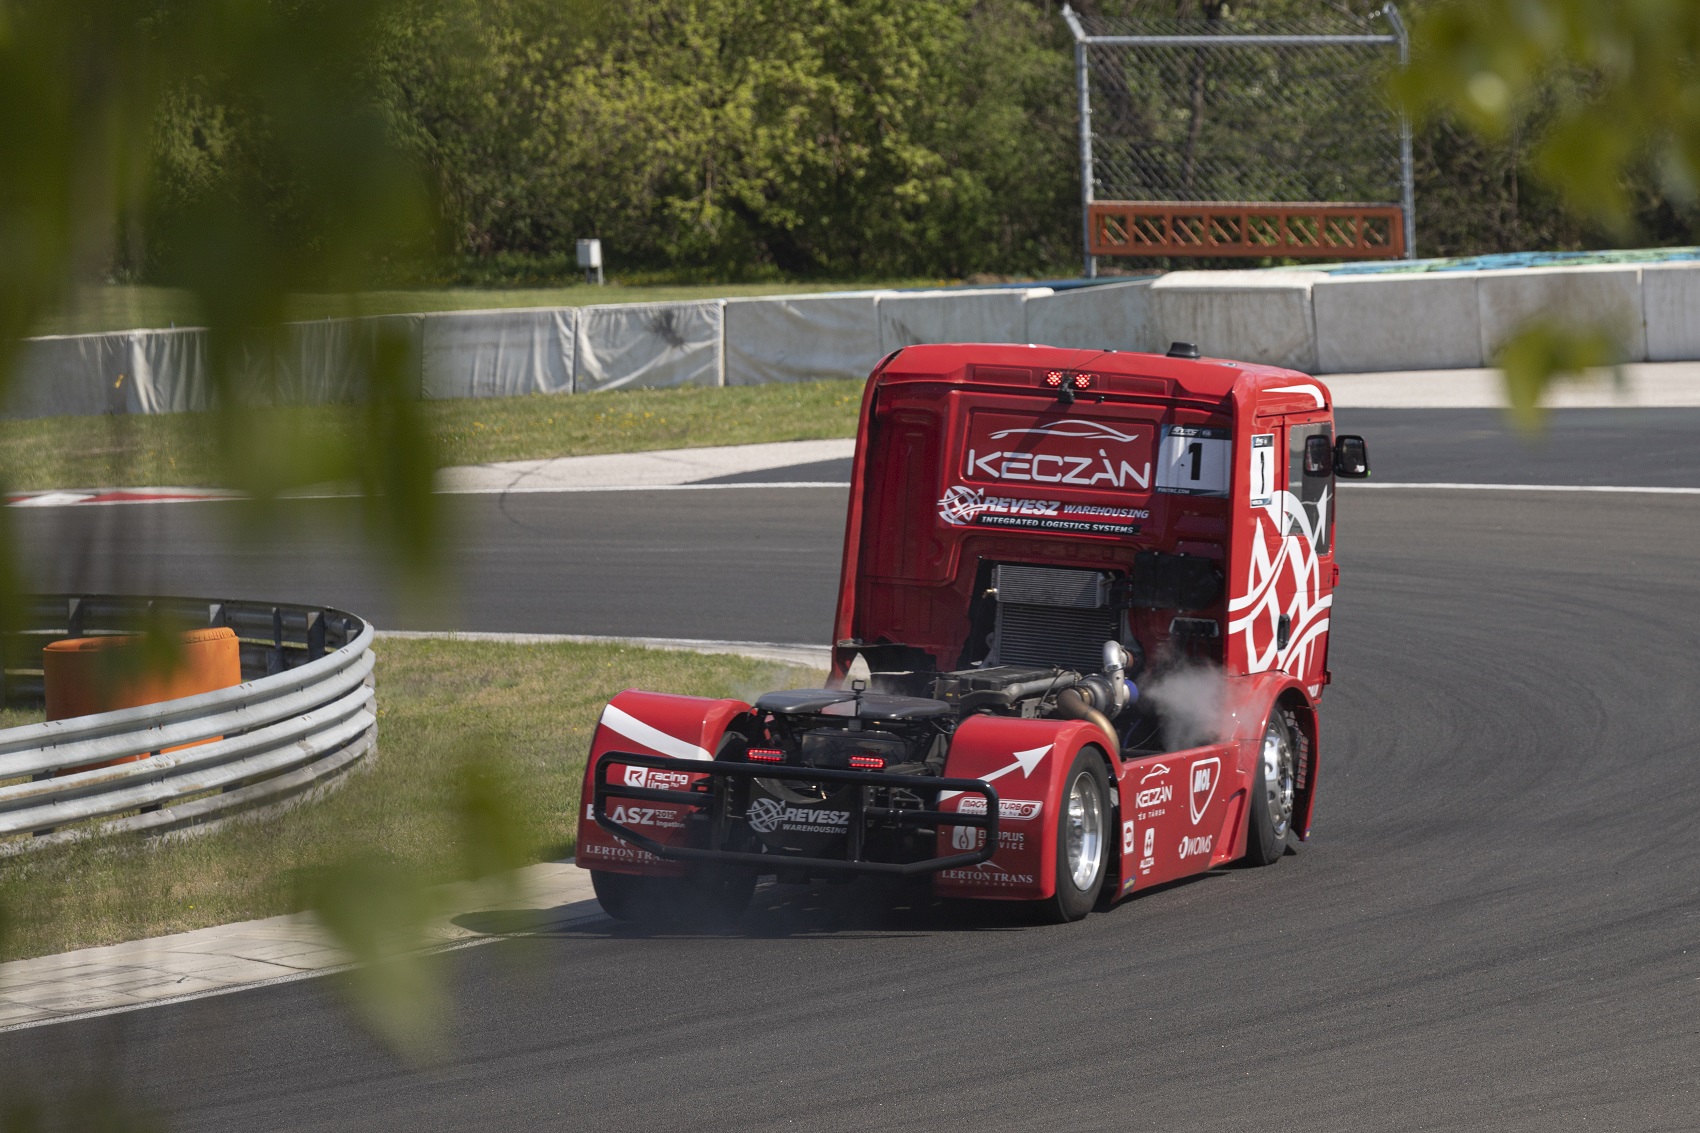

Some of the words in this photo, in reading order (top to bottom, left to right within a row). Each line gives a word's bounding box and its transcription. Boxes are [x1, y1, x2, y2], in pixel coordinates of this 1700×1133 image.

[1188, 442, 1202, 480] 1
[983, 496, 1060, 516] REVESZ
[1063, 504, 1149, 519] WAREHOUSING
[981, 516, 1038, 526] INTEGRATED
[1041, 521, 1089, 530] LOGISTICS
[1092, 524, 1134, 533] SYSTEMS
[648, 771, 689, 785] racing
[1193, 768, 1211, 793] MOL
[784, 807, 850, 825] REVESZ
[782, 823, 848, 834] WAREHOUSING
[586, 845, 635, 858] LERTON
[978, 840, 1025, 851] SVICE
[942, 869, 991, 881] LERTON
[993, 872, 1033, 884] TRANS
